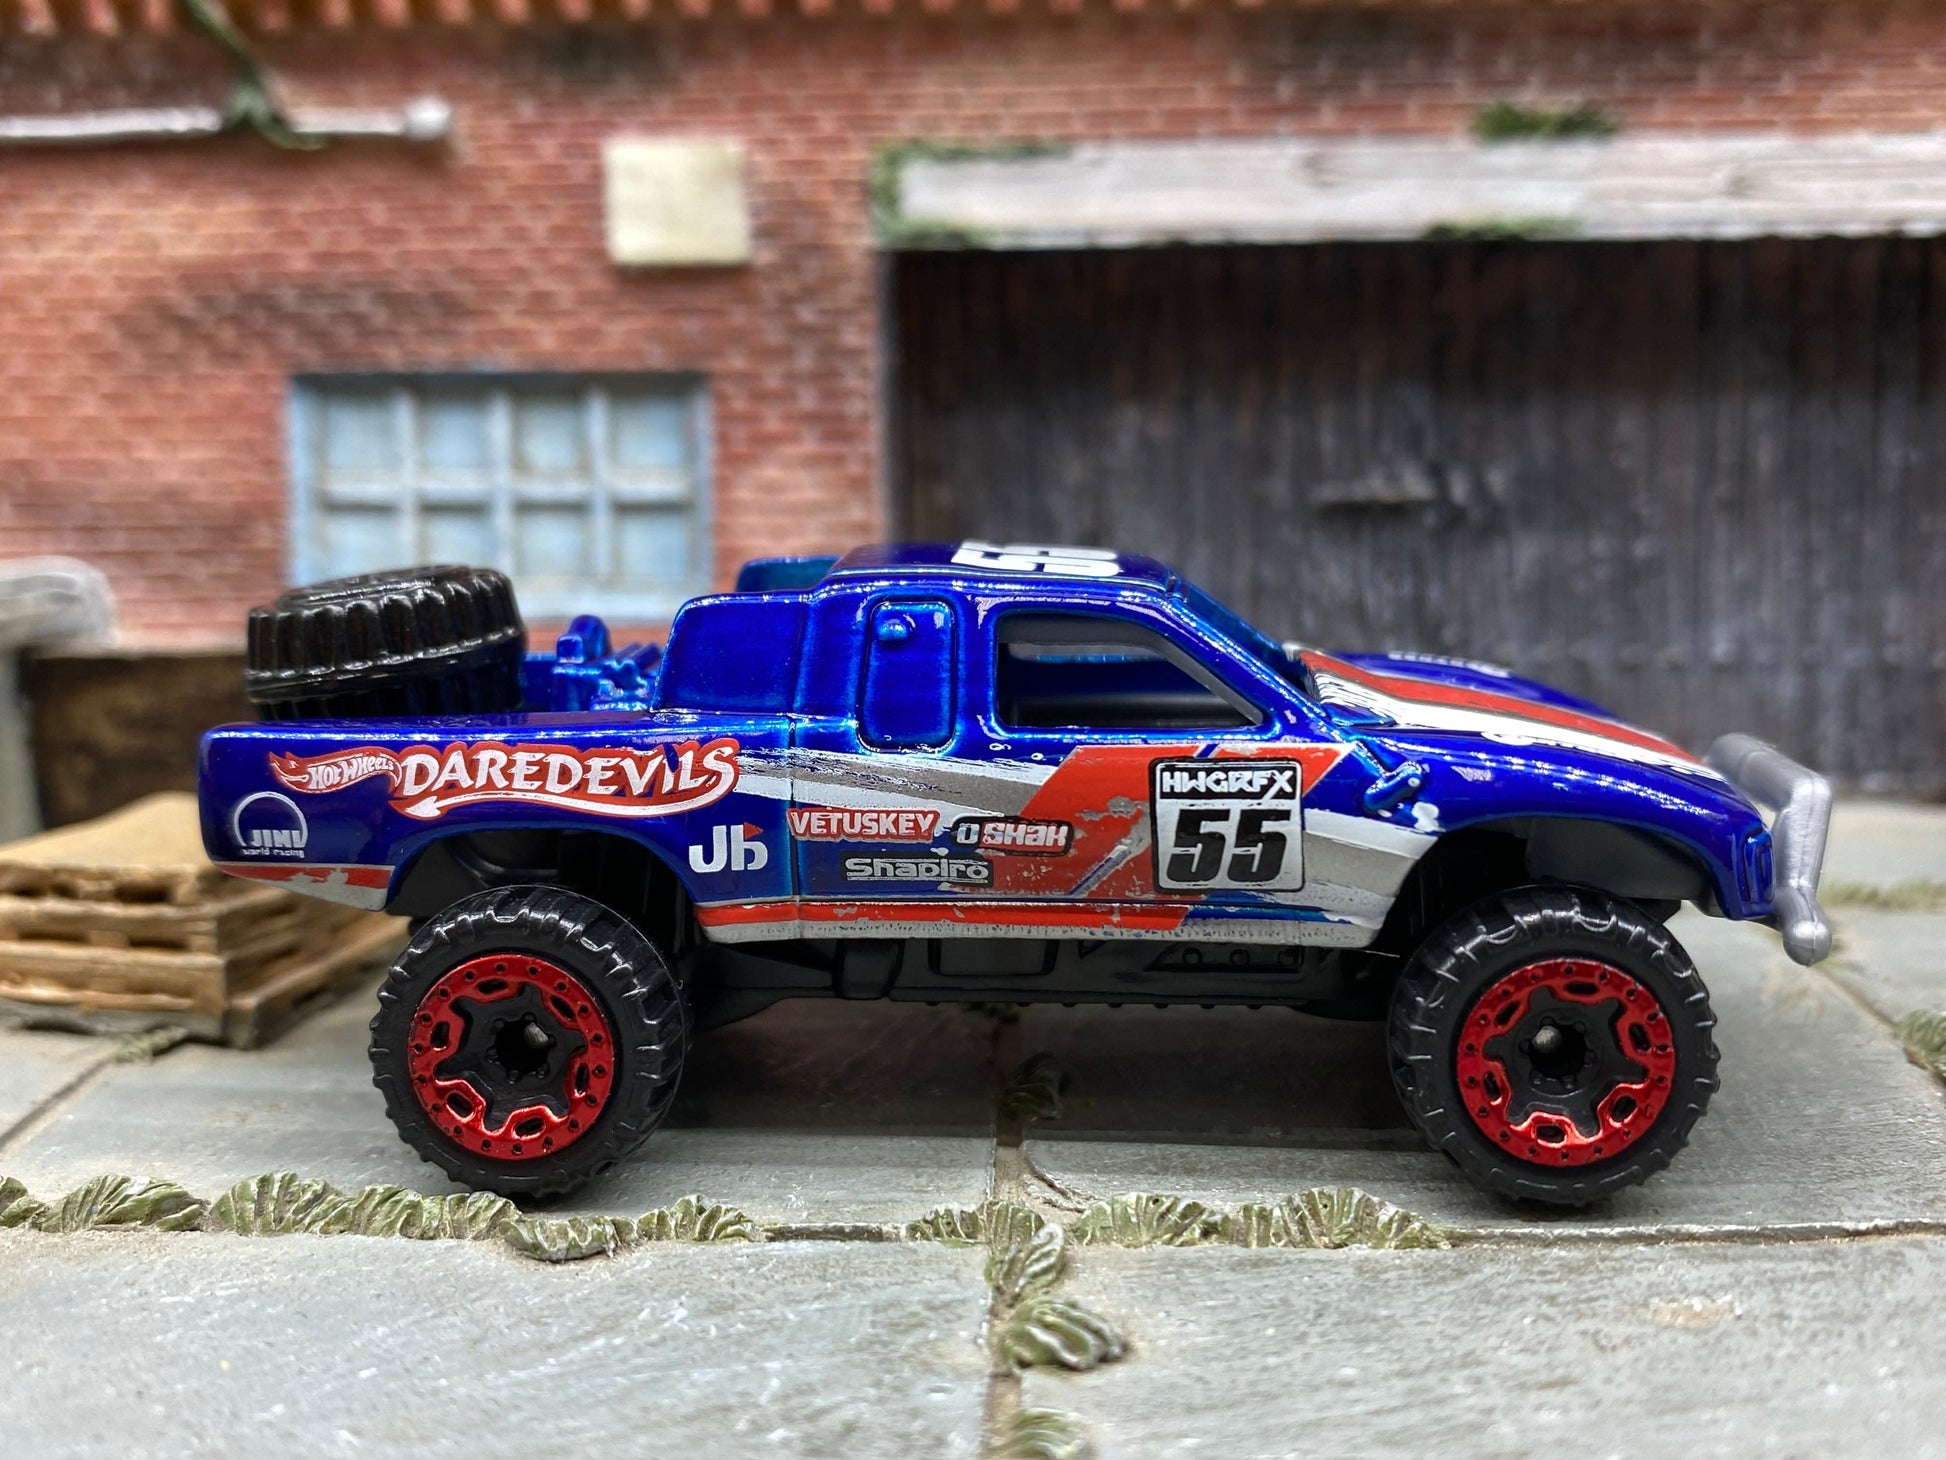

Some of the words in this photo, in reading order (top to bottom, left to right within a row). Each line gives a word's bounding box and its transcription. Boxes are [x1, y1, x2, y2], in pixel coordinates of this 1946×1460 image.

[401, 747, 735, 797] DAREDEVILS
[790, 811, 934, 837] VETUSKEY
[1166, 808, 1292, 882] 55
